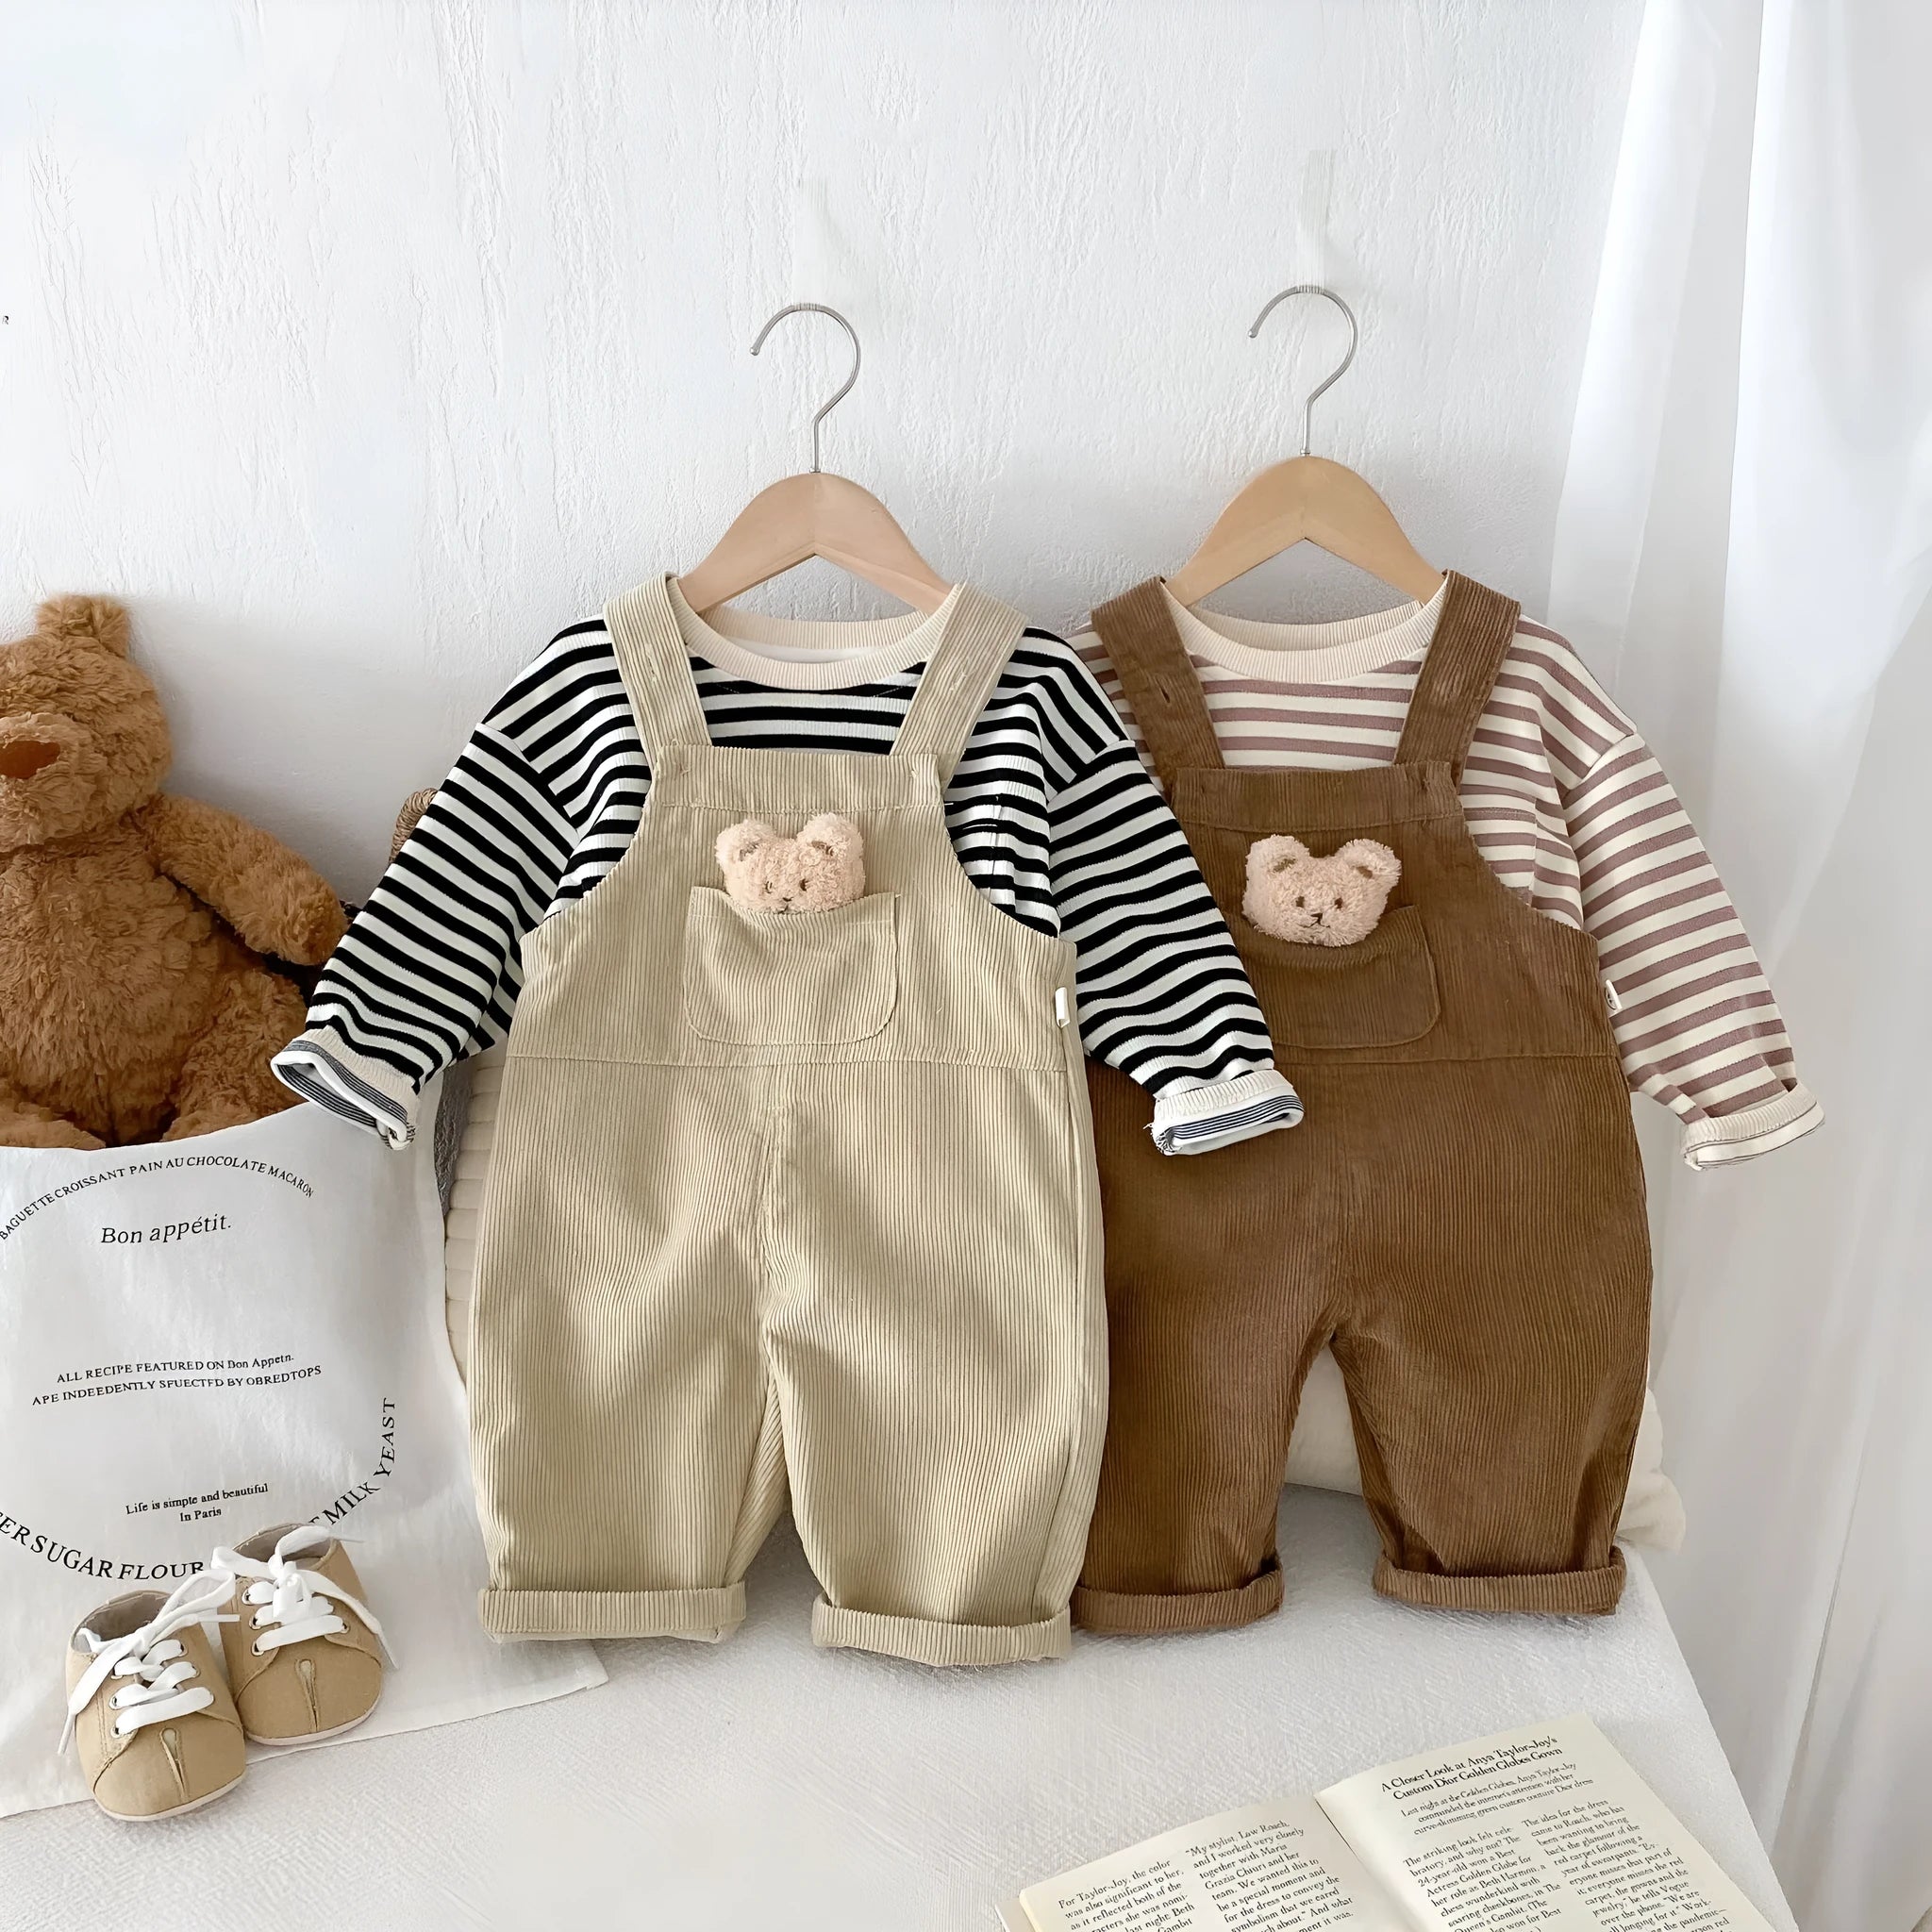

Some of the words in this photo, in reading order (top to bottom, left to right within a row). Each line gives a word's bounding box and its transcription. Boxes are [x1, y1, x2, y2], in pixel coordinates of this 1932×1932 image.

[0, 1193, 56, 1241] BAGUETTE
[54, 1168, 126, 1199] CROISSANT
[129, 1160, 163, 1175] PAIN
[165, 1157, 185, 1169] AU
[186, 1156, 268, 1174] CHOCOLATE
[267, 1165, 314, 1198] MACARON
[101, 1226, 142, 1244] Bon
[149, 1213, 232, 1243] appétit.
[57, 1372, 83, 1383] ALL
[86, 1363, 133, 1379] RECIPE
[136, 1360, 205, 1374] FEATURED
[206, 1360, 225, 1372] ON
[227, 1377, 243, 1388] BY
[373, 1397, 395, 1477] YEAST
[125, 1502, 148, 1515] Life
[151, 1500, 160, 1510] is
[201, 1491, 220, 1503] and
[179, 1512, 192, 1522] In
[194, 1507, 222, 1520] Paris
[322, 1481, 381, 1525] MILK
[0, 1511, 31, 1547] ER
[30, 1535, 113, 1579] SUGAR
[117, 1561, 205, 1581] FLOUR
[1567, 1841, 1581, 1850] the
[1626, 1824, 1641, 1832] the
[1132, 1871, 1146, 1880] the
[1655, 1862, 1668, 1872] the
[1167, 1883, 1181, 1892] the
[1615, 1888, 1628, 1896] the
[1675, 1869, 1689, 1877] the
[1241, 1907, 1255, 1917] the
[1325, 1876, 1340, 1885] the
[1621, 1910, 1636, 1919] the
